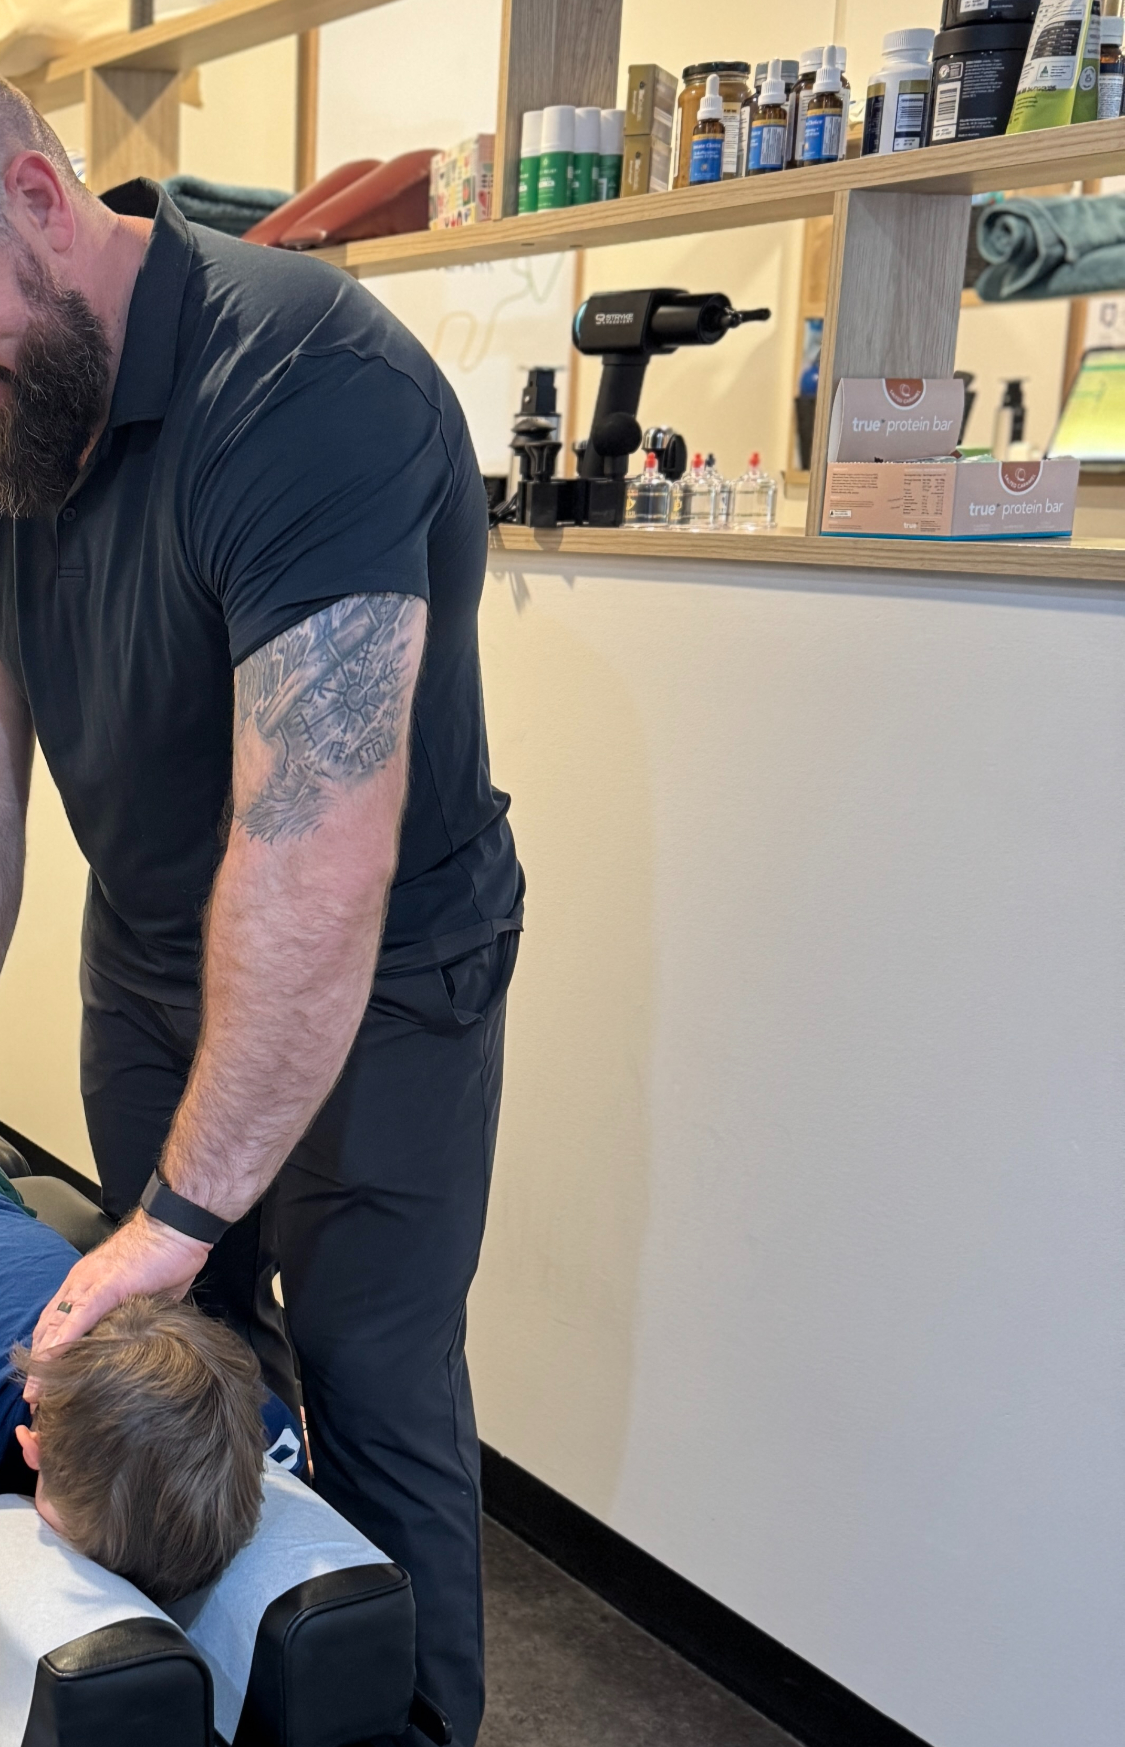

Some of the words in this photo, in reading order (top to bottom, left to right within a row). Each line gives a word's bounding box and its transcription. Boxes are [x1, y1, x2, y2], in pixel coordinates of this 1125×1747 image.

[852, 417, 881, 432] true
[886, 416, 930, 436] protein
[932, 415, 954, 431] bar
[969, 502, 996, 516] true
[1002, 499, 1043, 520] protein
[1045, 498, 1064, 513] bar
